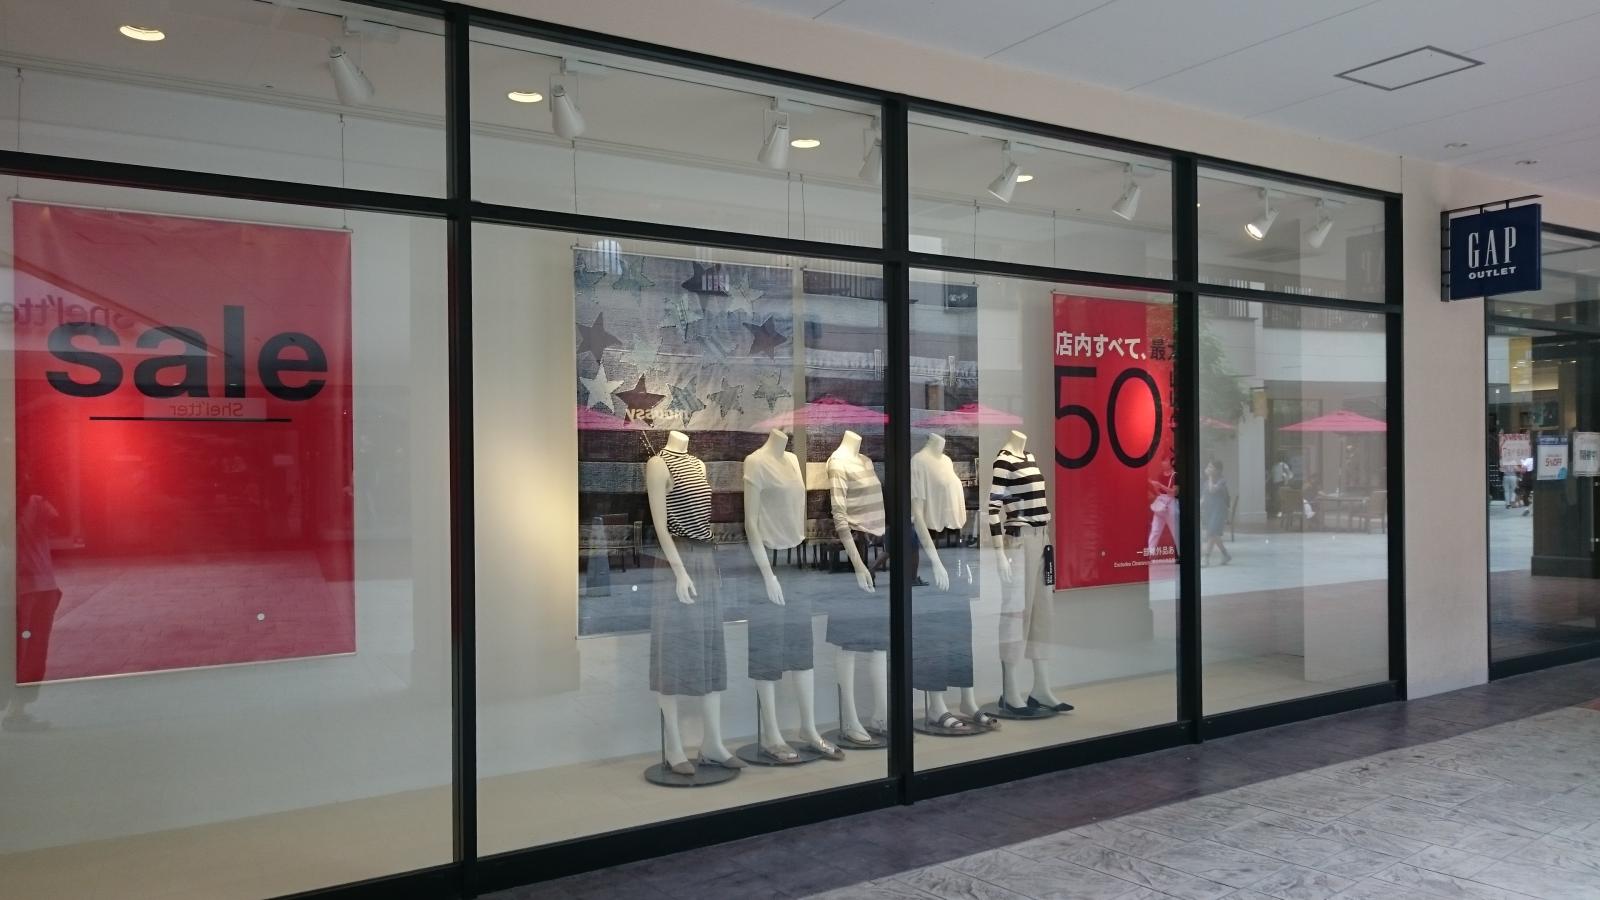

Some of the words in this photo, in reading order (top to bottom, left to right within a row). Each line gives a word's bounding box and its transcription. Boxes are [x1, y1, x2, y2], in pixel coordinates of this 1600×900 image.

[1468, 226, 1517, 269] GAP
[1468, 266, 1517, 280] OUTLET
[46, 305, 328, 401] sale
[1055, 365, 1163, 469] 50
